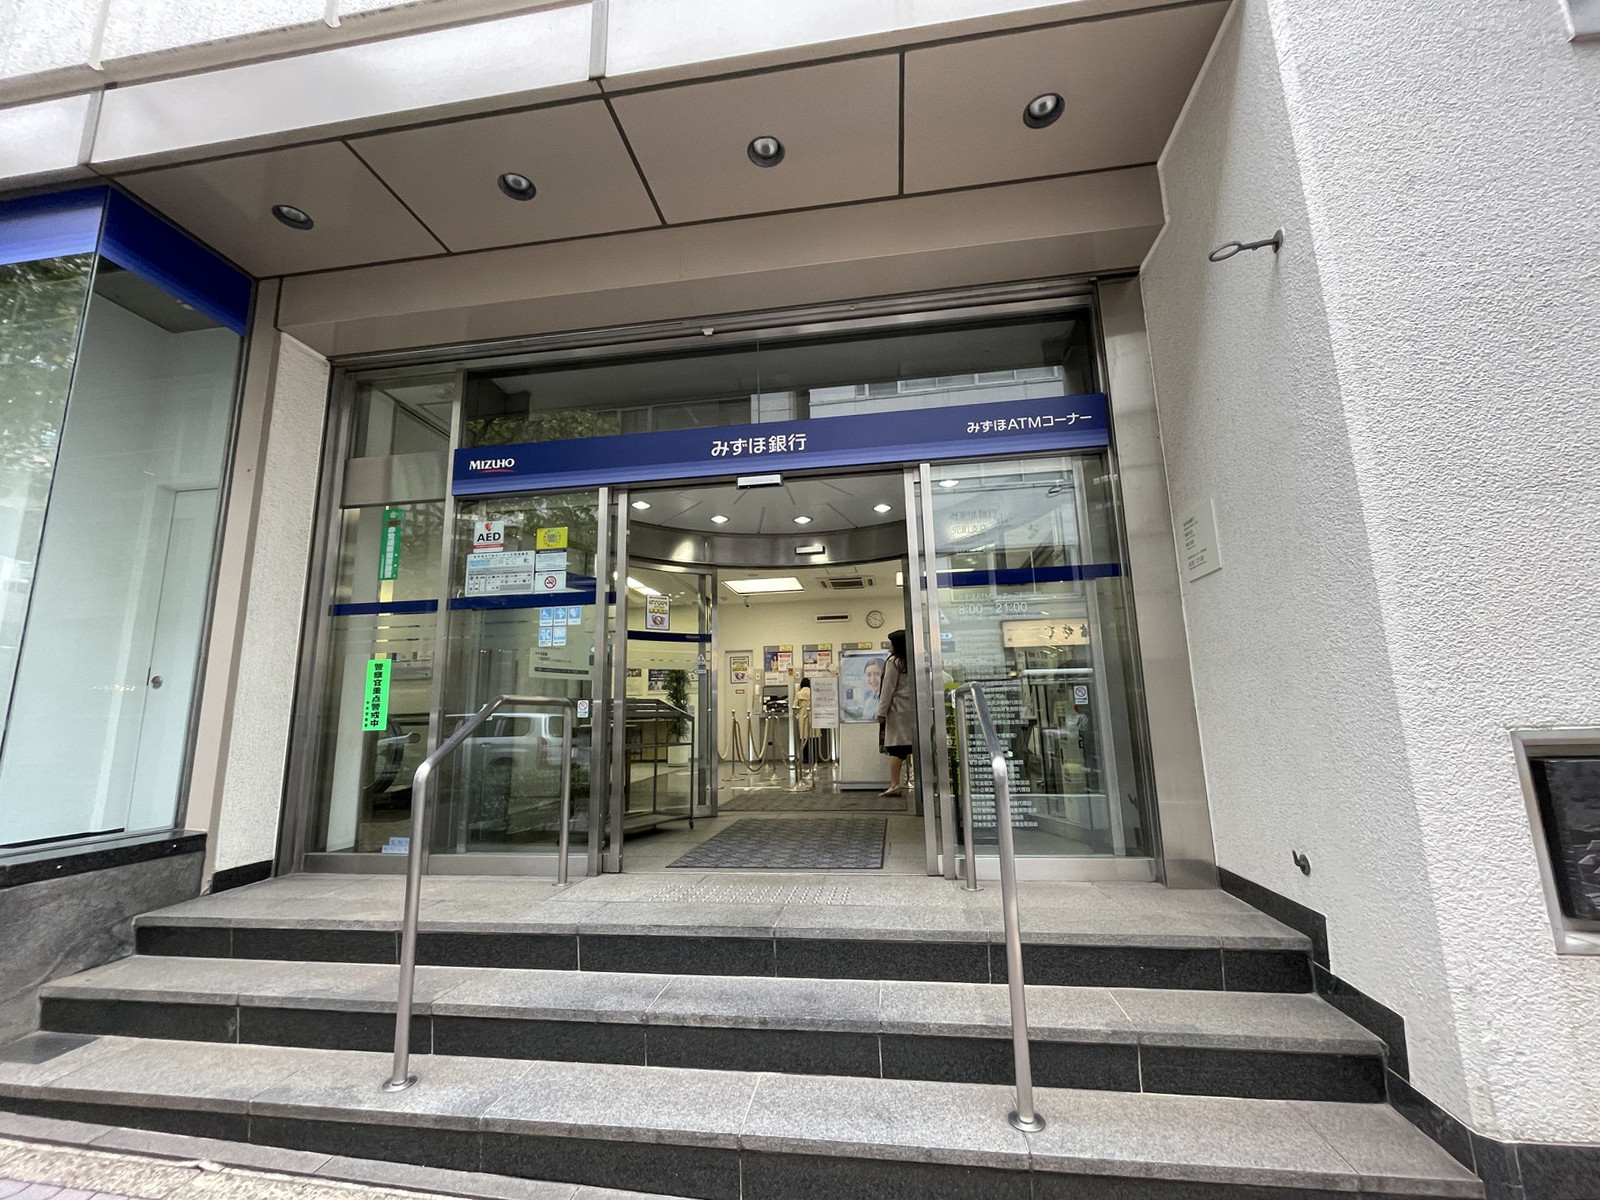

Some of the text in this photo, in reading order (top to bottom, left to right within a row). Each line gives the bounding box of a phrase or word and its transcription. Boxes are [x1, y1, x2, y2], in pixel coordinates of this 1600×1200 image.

[966, 412, 1092, 434] みずほATMコーナー
[711, 433, 807, 456] みずほ銀行
[468, 457, 515, 471] MIZUHO
[476, 532, 502, 543] AED
[370, 663, 384, 727] 警察官重点警戒中
